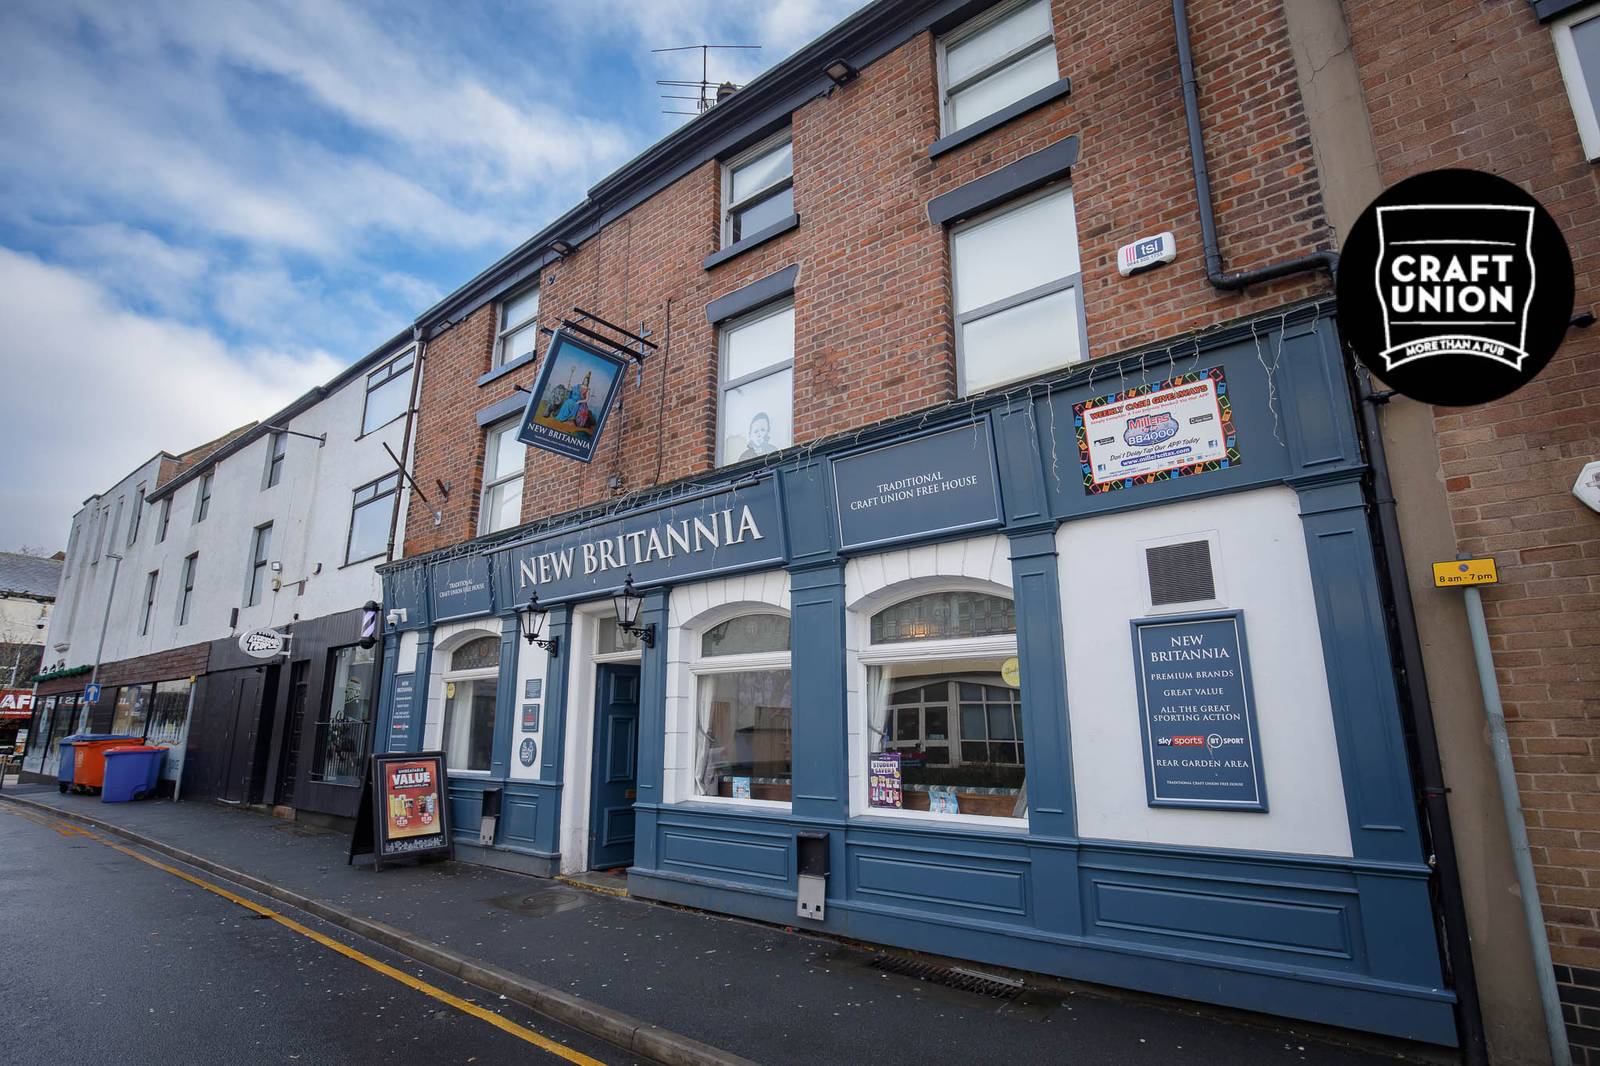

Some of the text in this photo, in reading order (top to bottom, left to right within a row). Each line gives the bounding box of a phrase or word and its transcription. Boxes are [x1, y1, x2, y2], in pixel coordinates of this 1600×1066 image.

[1141, 241, 1159, 255] tsl
[1090, 405, 1124, 420] WEEKLY
[1125, 398, 1151, 411] CASH
[1151, 384, 1208, 405] GIVEAWAYS
[527, 423, 548, 436] NEW
[548, 427, 591, 449] BRITANNIA
[1128, 427, 1175, 445] 884000
[1110, 452, 1126, 462] Don't
[1126, 449, 1143, 458] Delay
[1182, 437, 1200, 446] Today
[877, 471, 944, 493] TRADITIONAL
[850, 475, 978, 511] CRAFT UNION FREE HOUSE
[519, 504, 765, 589] NEW BRITANNIA
[1171, 634, 1204, 648] NEW
[1150, 647, 1230, 663] BRITANNIA
[1150, 669, 1234, 681] PREMIUM BRANDS
[1163, 687, 1224, 697] GREAT VALUE
[1160, 704, 1231, 714] ALL THE GREAT
[1153, 712, 1241, 723] SPORTING ACTION
[1158, 736, 1172, 747] sky
[1174, 735, 1203, 747] sports
[1223, 737, 1244, 745] SPORT
[1156, 759, 1249, 769] REAR GARDEN AREA
[392, 772, 431, 785] VALUE
